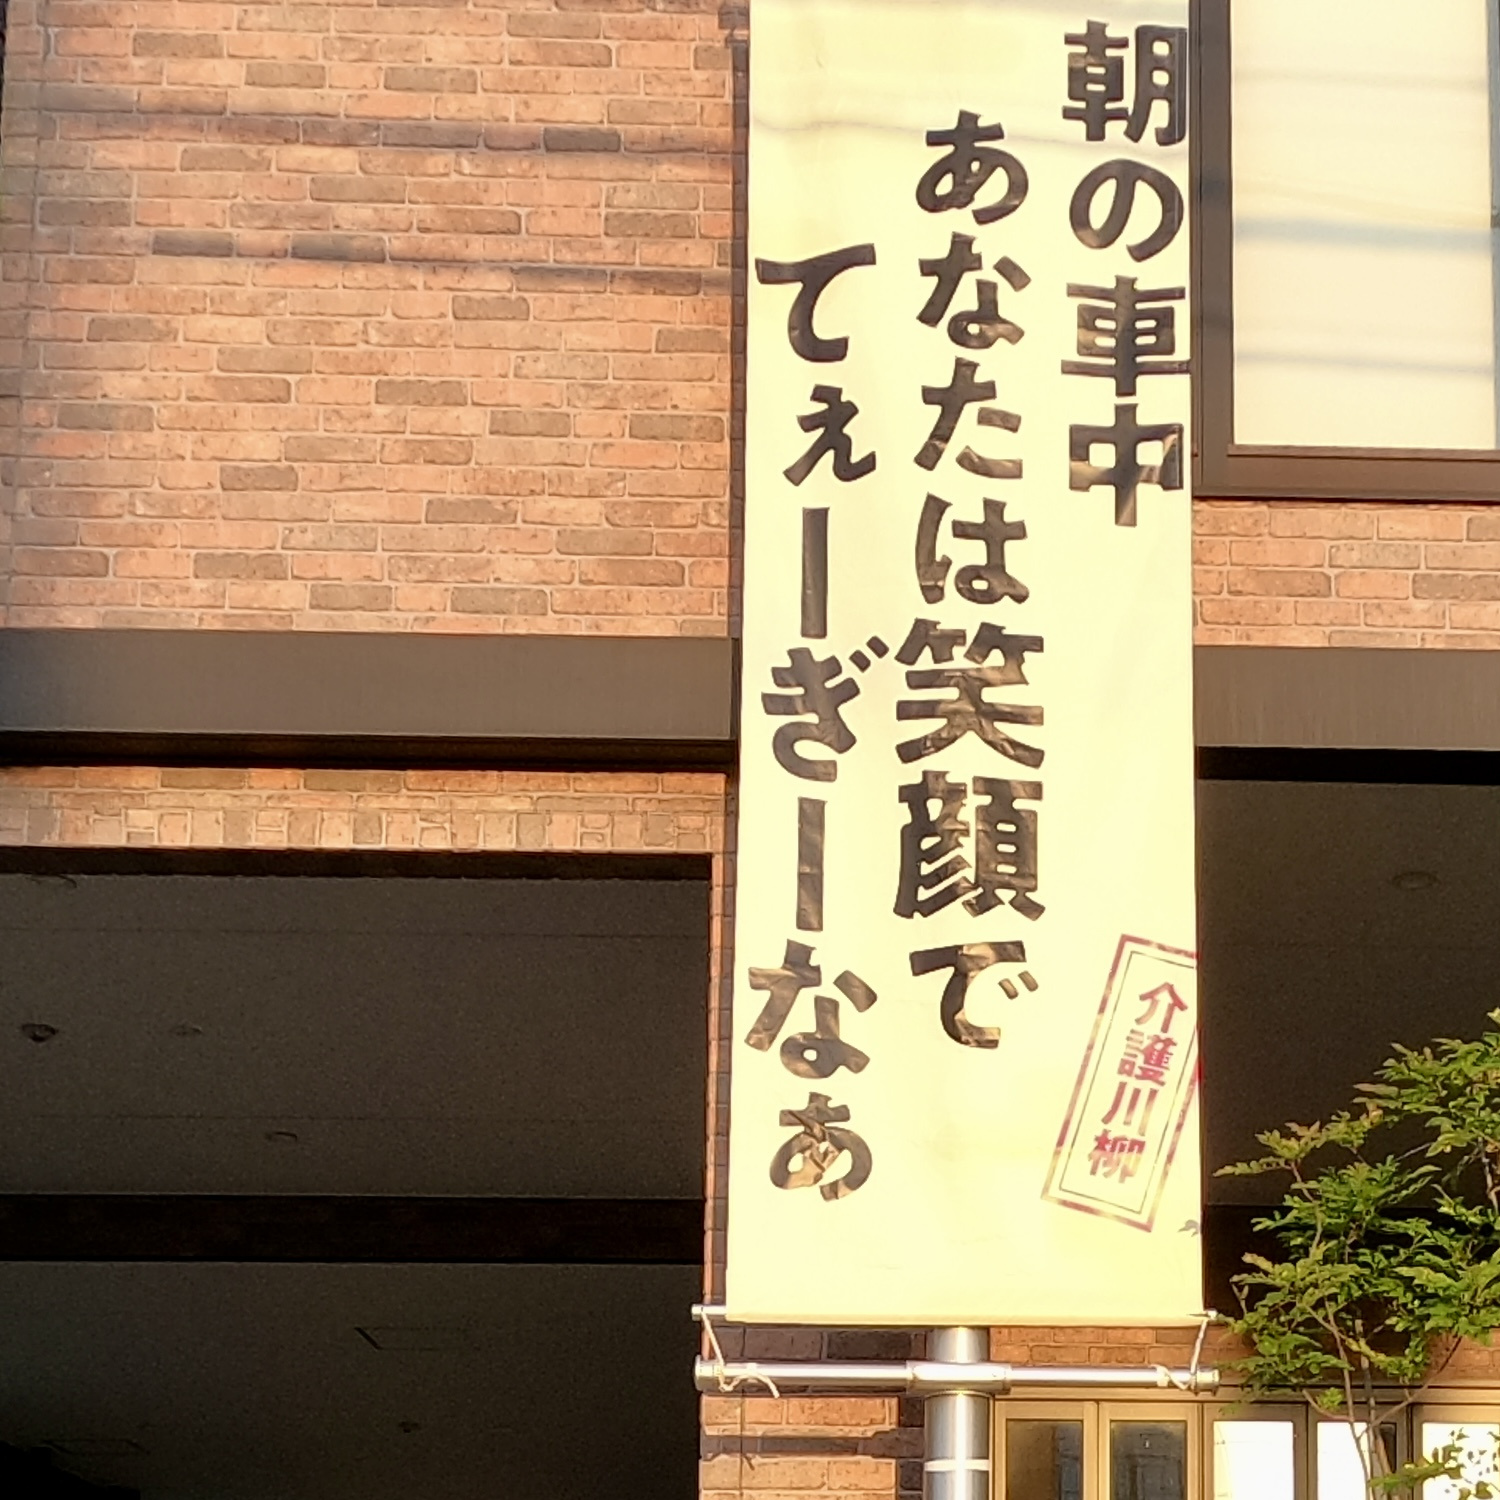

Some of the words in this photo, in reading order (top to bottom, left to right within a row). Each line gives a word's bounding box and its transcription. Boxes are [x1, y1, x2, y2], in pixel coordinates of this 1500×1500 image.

[1061, 20, 1192, 527] 朝の車中
[893, 110, 1046, 1048] あなたは笑顔で
[1087, 982, 1188, 1184] 介護川柳
